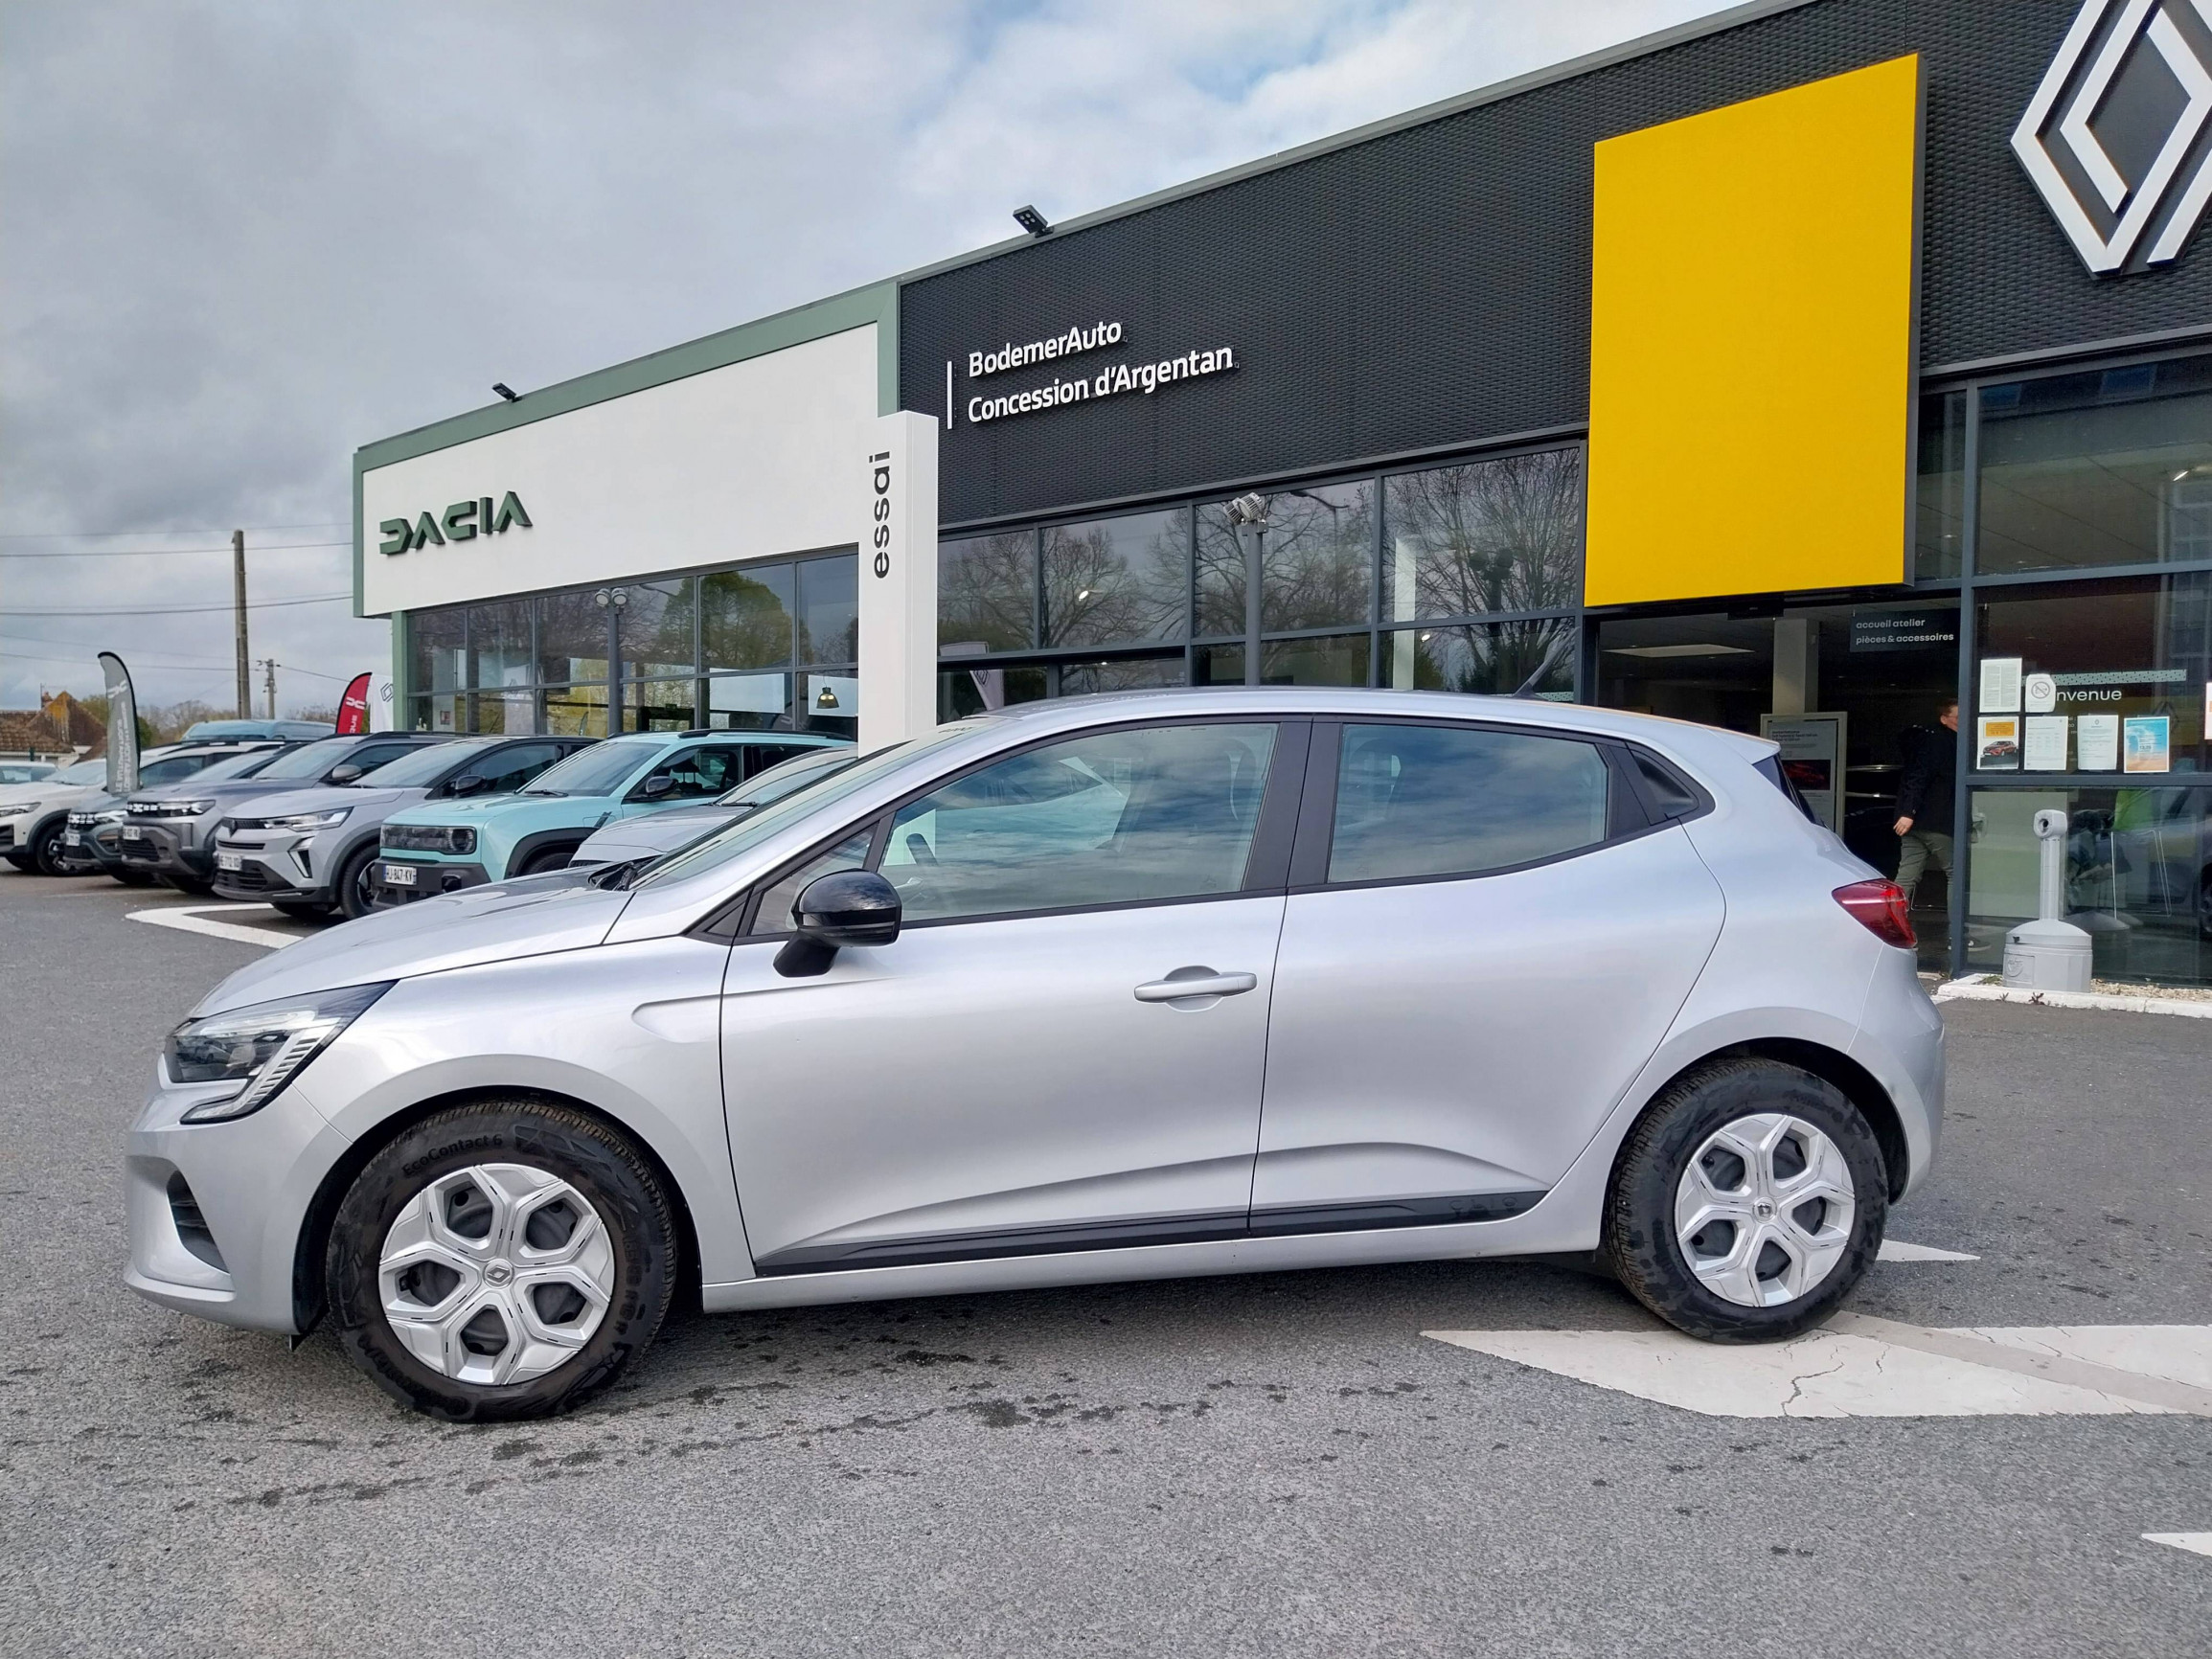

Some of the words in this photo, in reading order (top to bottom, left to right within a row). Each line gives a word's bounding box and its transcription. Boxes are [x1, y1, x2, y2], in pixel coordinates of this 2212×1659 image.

[969, 321, 1123, 377] BodemerAuto
[968, 377, 1090, 422] Concession
[1094, 346, 1235, 394] d'Argentan
[379, 490, 534, 556] DACIA
[868, 450, 891, 580] essai
[1856, 619, 1891, 629] accueil
[1892, 618, 1926, 628] atelier
[1856, 635, 1886, 646] pièces
[1896, 632, 1954, 643] accessoires
[2056, 689, 2123, 701] nvenue
[401, 1134, 490, 1178] EcoContact
[492, 1133, 504, 1147] 6
